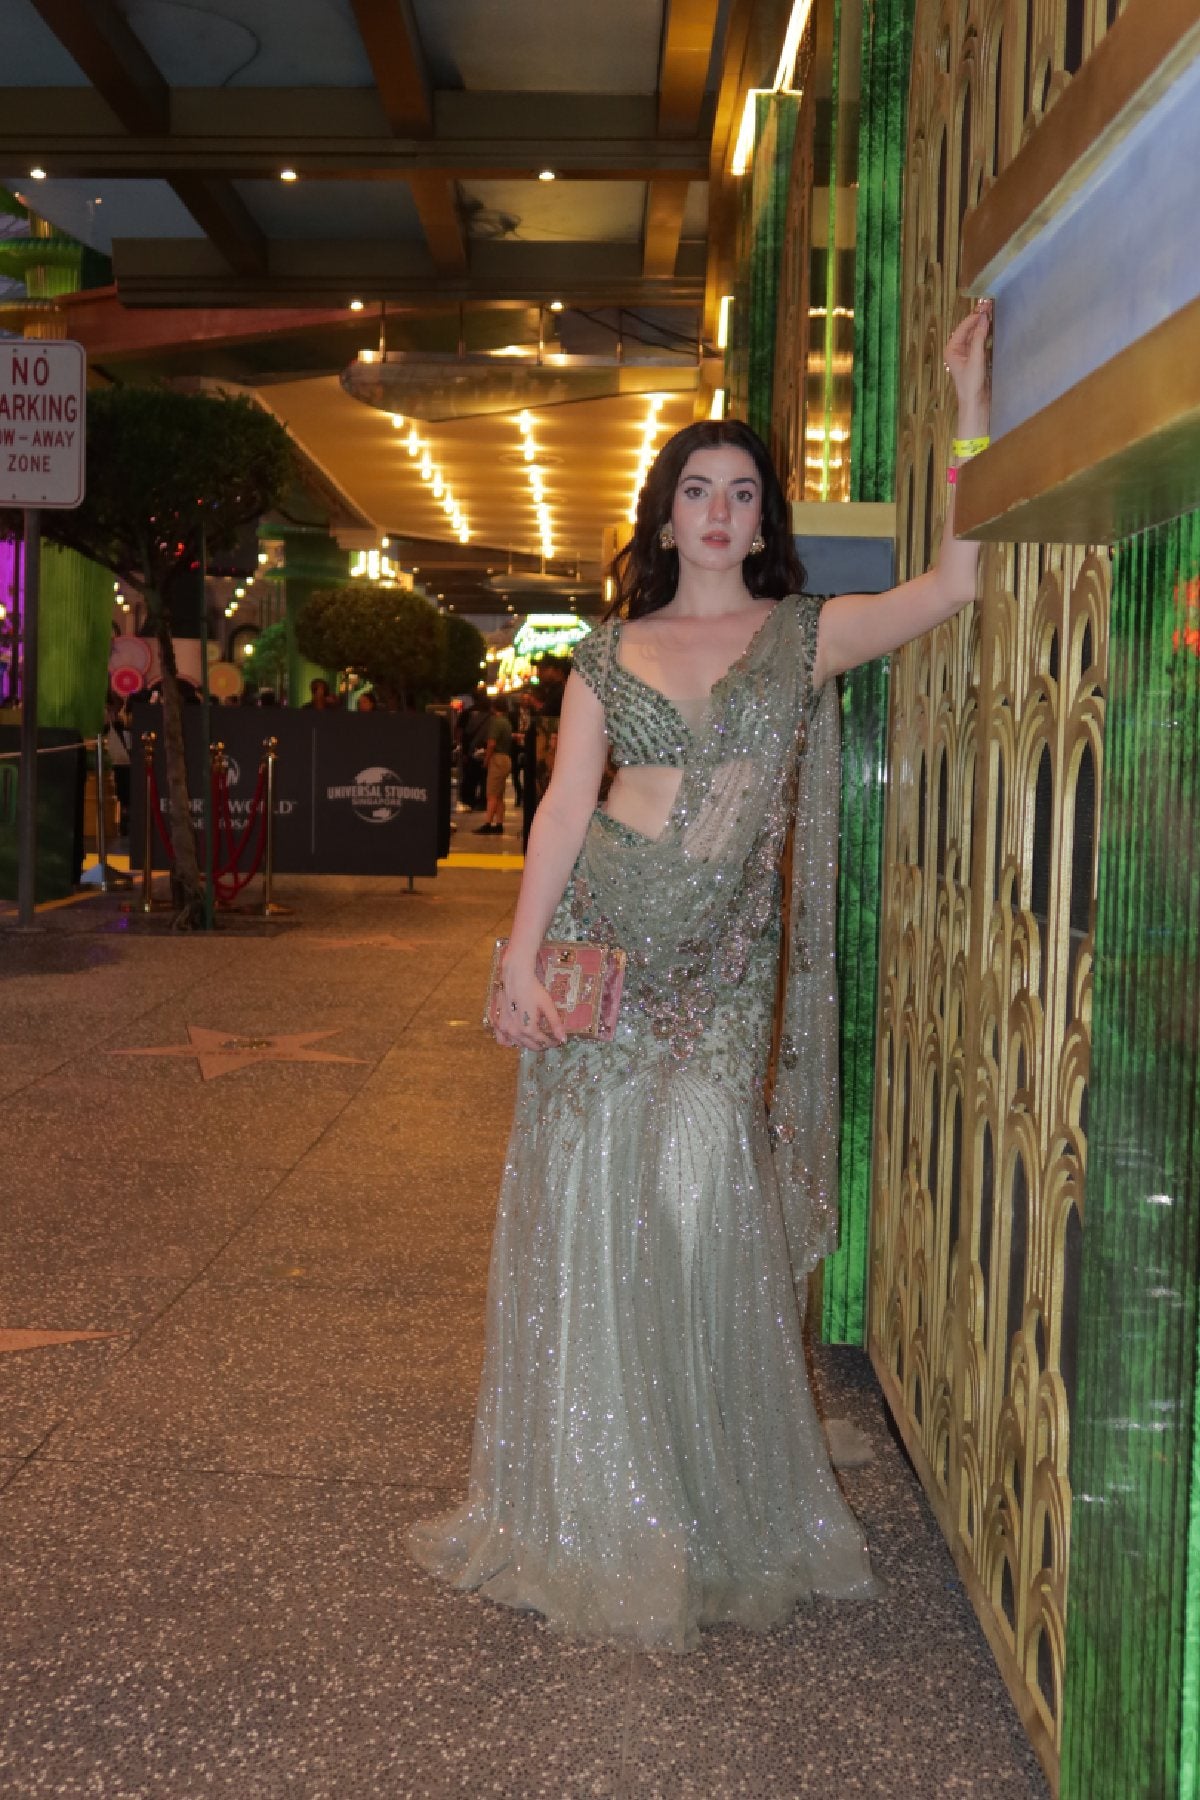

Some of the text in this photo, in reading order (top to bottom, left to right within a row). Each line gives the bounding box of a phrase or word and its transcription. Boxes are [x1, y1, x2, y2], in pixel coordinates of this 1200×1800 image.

[12, 357, 49, 386] NO
[8, 454, 51, 472] ZONE
[327, 785, 427, 802] UNIVERSAL STUDIOS
